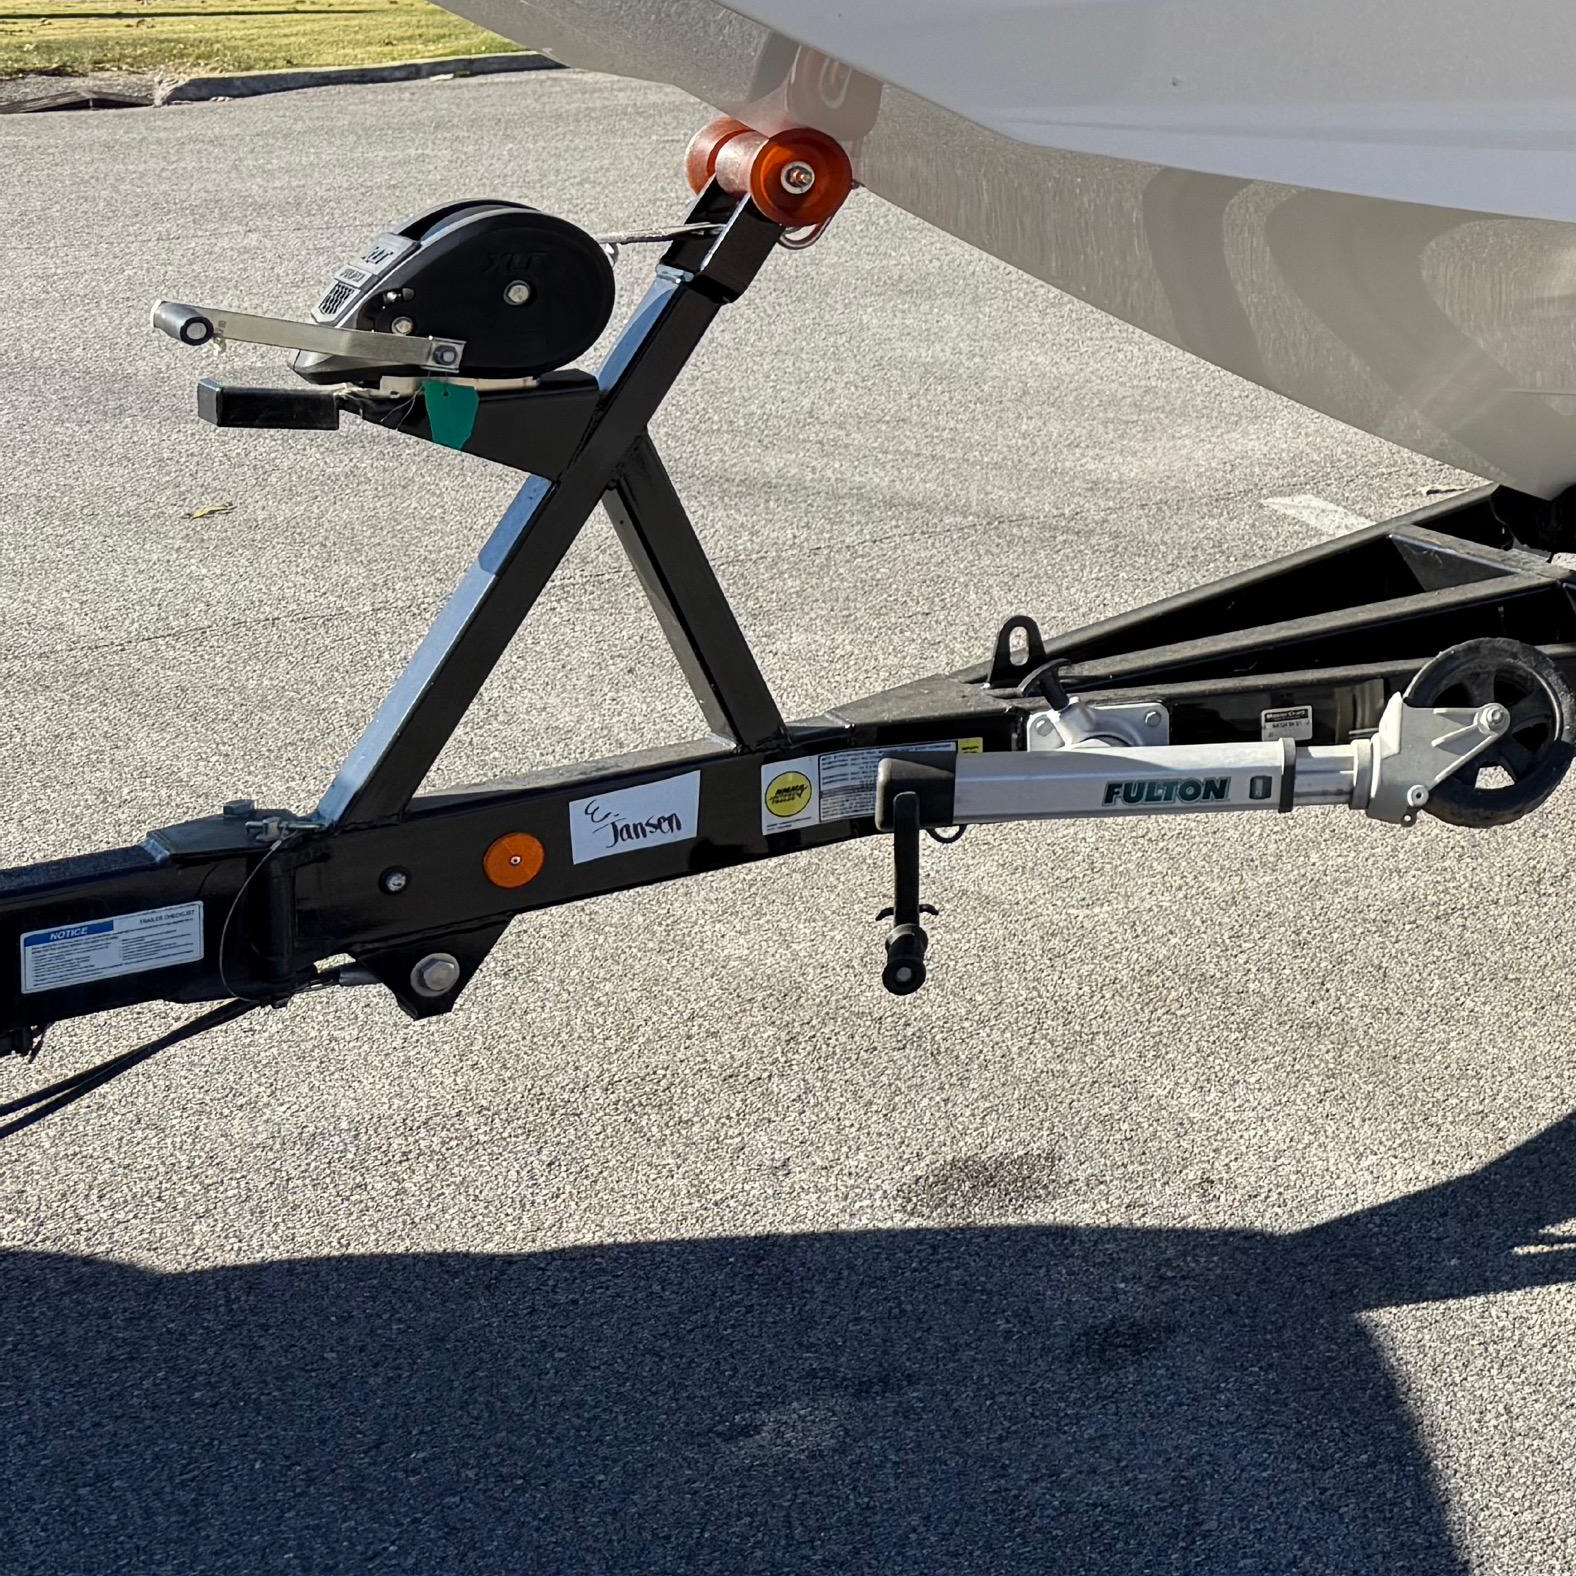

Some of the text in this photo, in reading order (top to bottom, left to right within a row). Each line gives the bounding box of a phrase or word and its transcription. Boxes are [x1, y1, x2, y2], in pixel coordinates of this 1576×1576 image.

[1101, 776, 1232, 807] FULTON
[592, 812, 682, 849] Jansen
[49, 926, 89, 941] NOTICE
